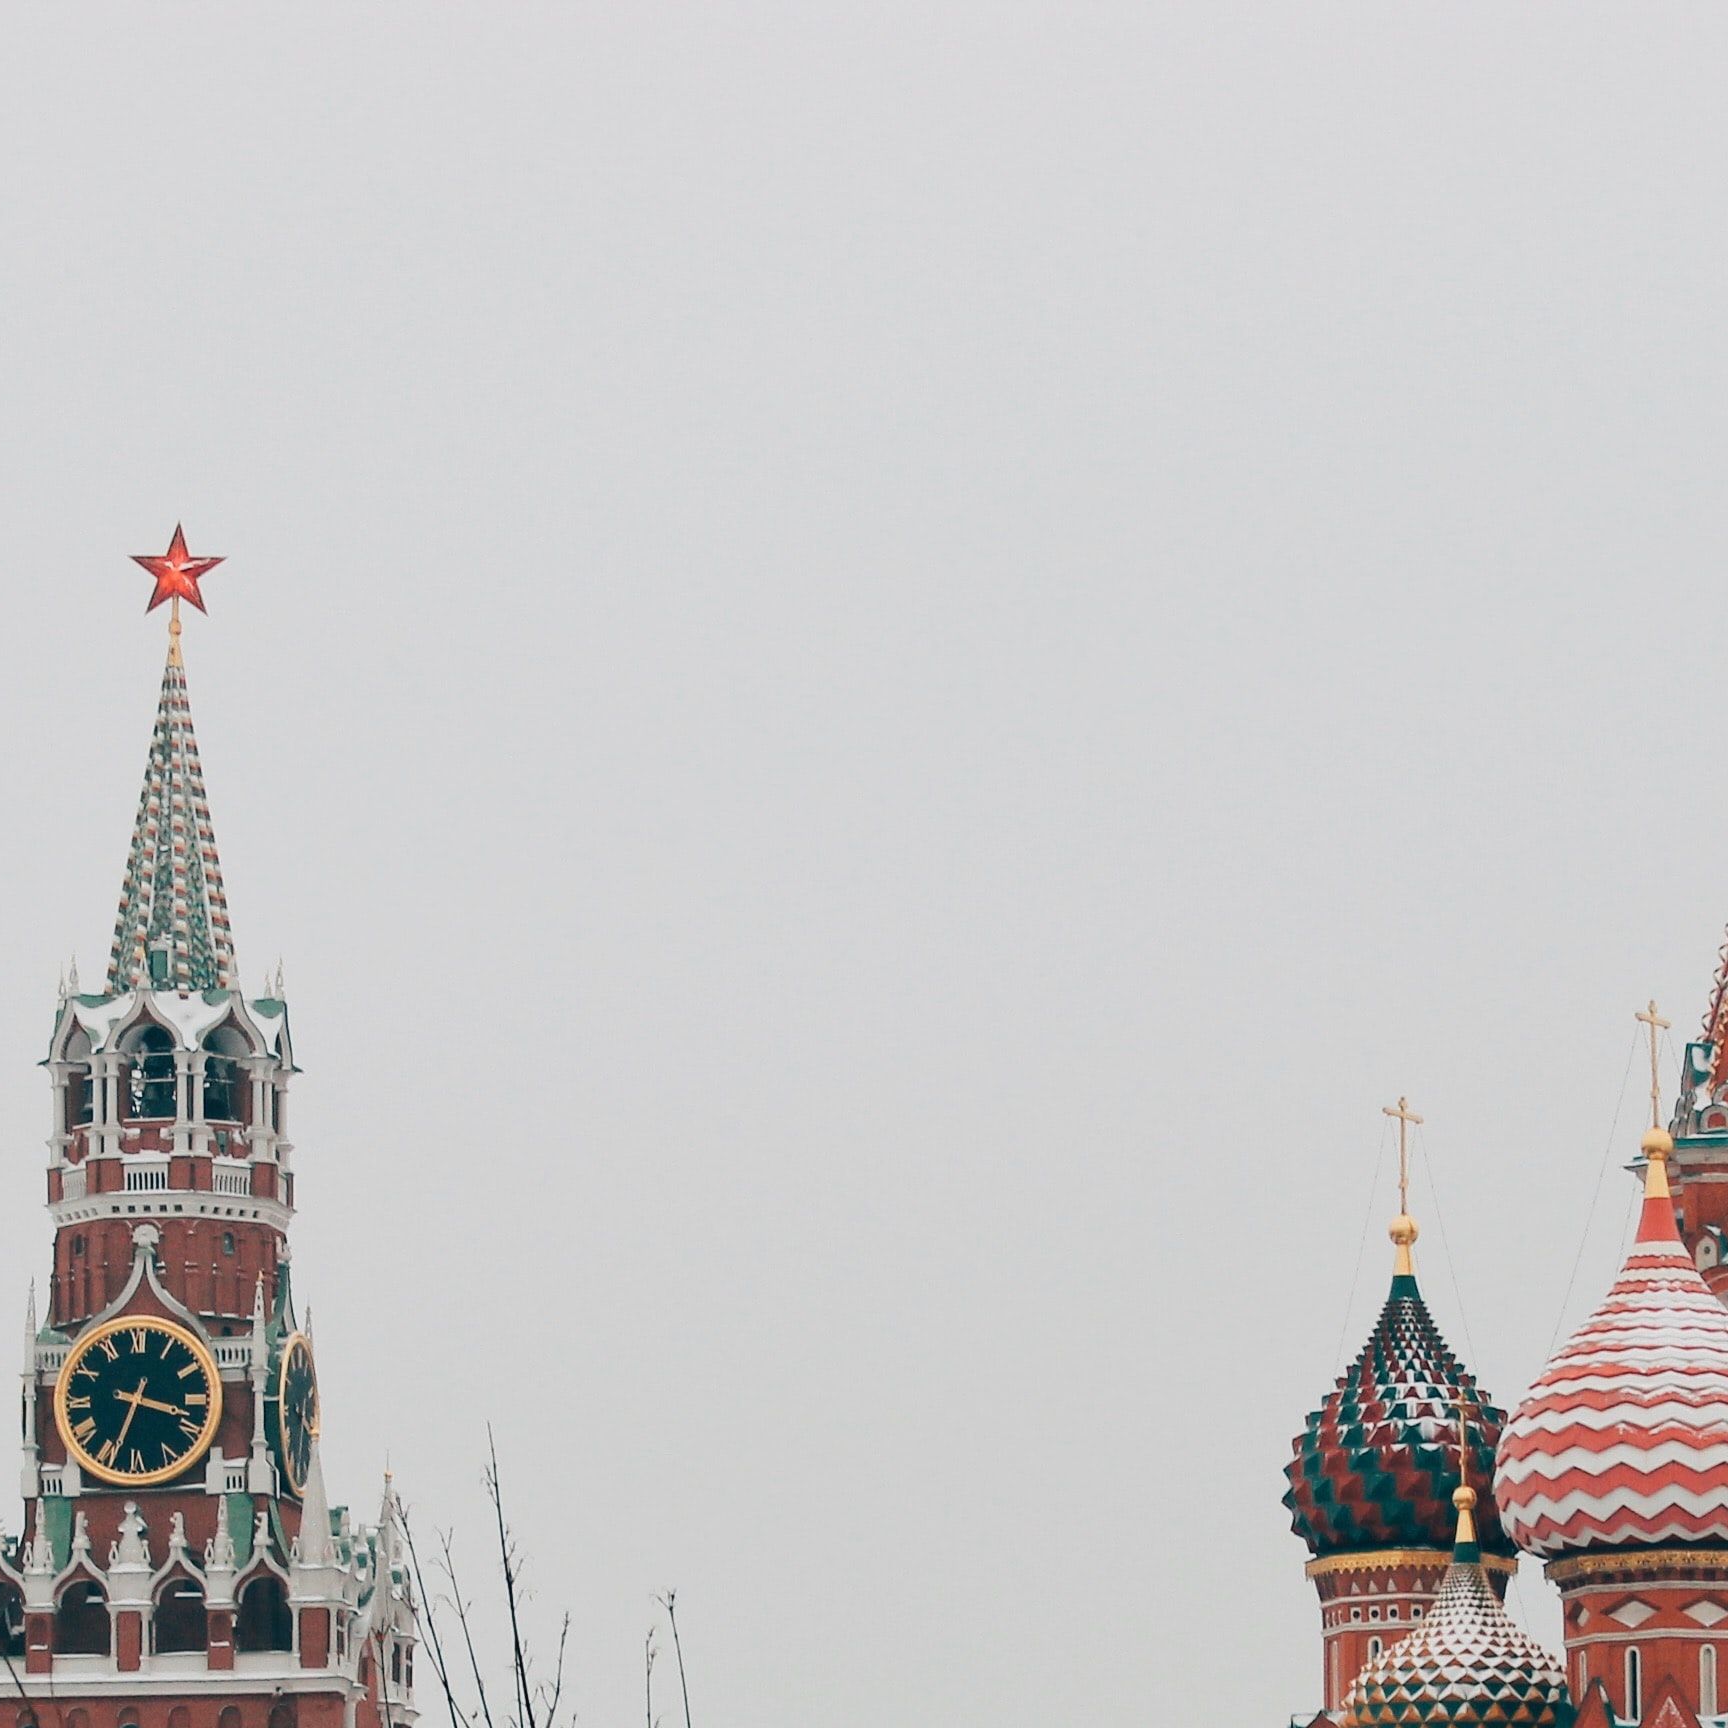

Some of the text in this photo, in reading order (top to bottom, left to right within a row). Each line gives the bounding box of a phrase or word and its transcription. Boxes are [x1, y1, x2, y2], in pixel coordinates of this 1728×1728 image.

[99, 1337, 119, 1363] XI
[130, 1329, 146, 1353] XII
[160, 1337, 175, 1360] I
[76, 1359, 99, 1381] X
[177, 1362, 198, 1379] II
[68, 1394, 91, 1409] IX
[185, 1393, 206, 1405] III
[73, 1416, 97, 1446] VIII
[179, 1418, 202, 1444] IV
[96, 1438, 117, 1468] VII
[130, 1448, 146, 1474] VI
[161, 1442, 179, 1467] V
